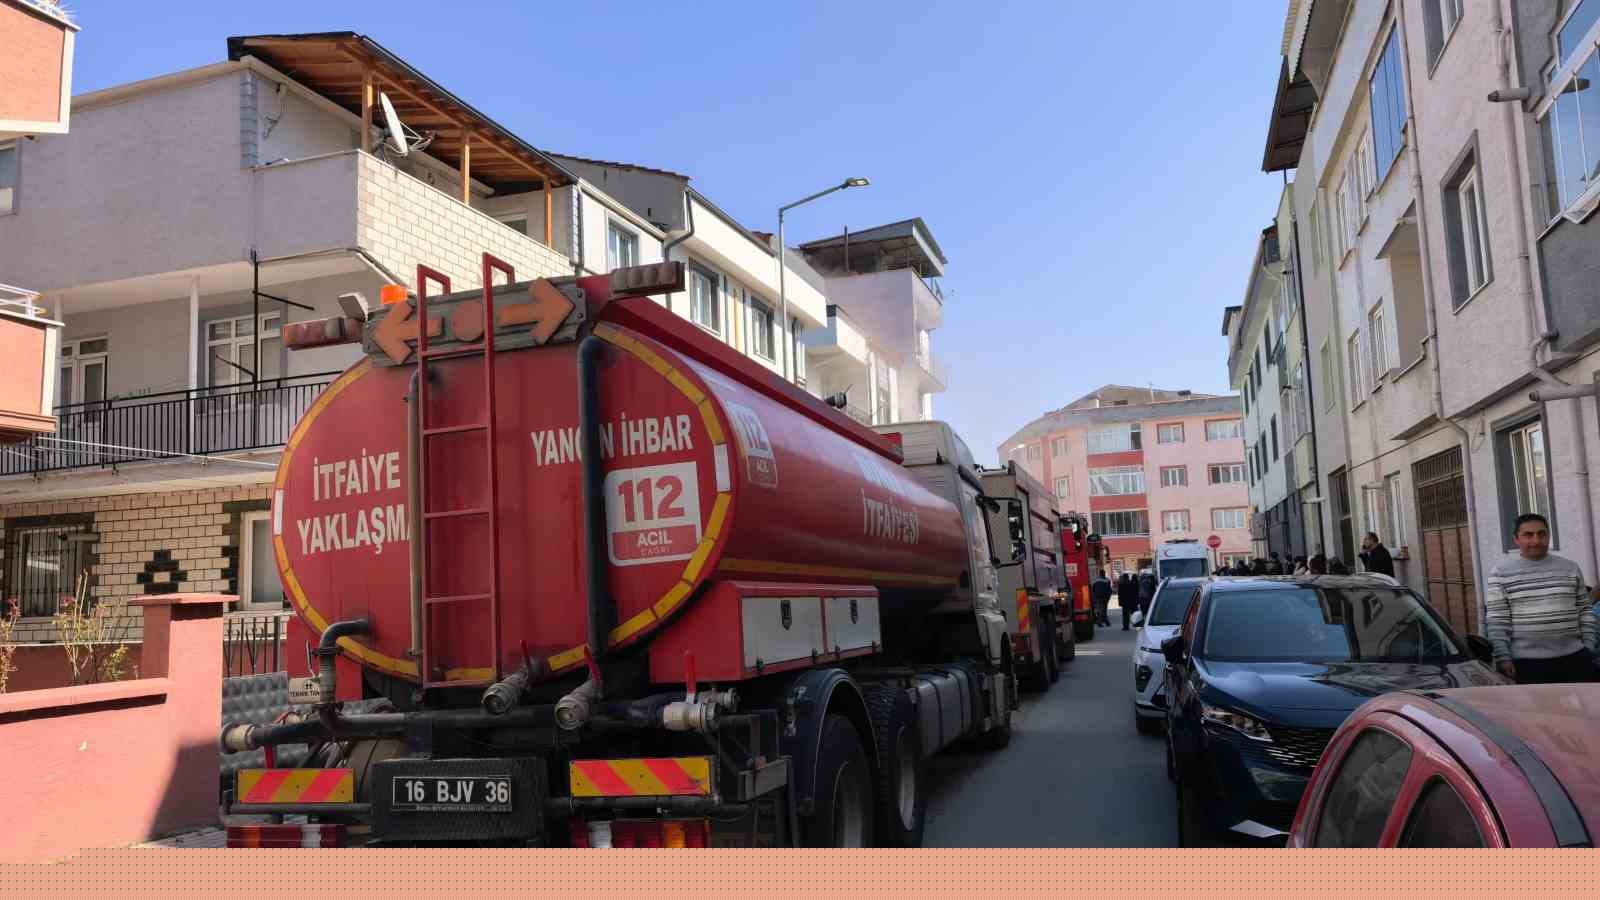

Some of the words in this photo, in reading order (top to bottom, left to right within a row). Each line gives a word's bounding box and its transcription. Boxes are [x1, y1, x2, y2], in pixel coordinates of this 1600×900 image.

[530, 422, 615, 467] YANN
[621, 411, 694, 457] İHBAR
[313, 447, 401, 501] İTFAİYE
[617, 475, 685, 523] 112
[405, 780, 425, 802] 16
[437, 780, 474, 803] BJV
[485, 781, 508, 803] 36
